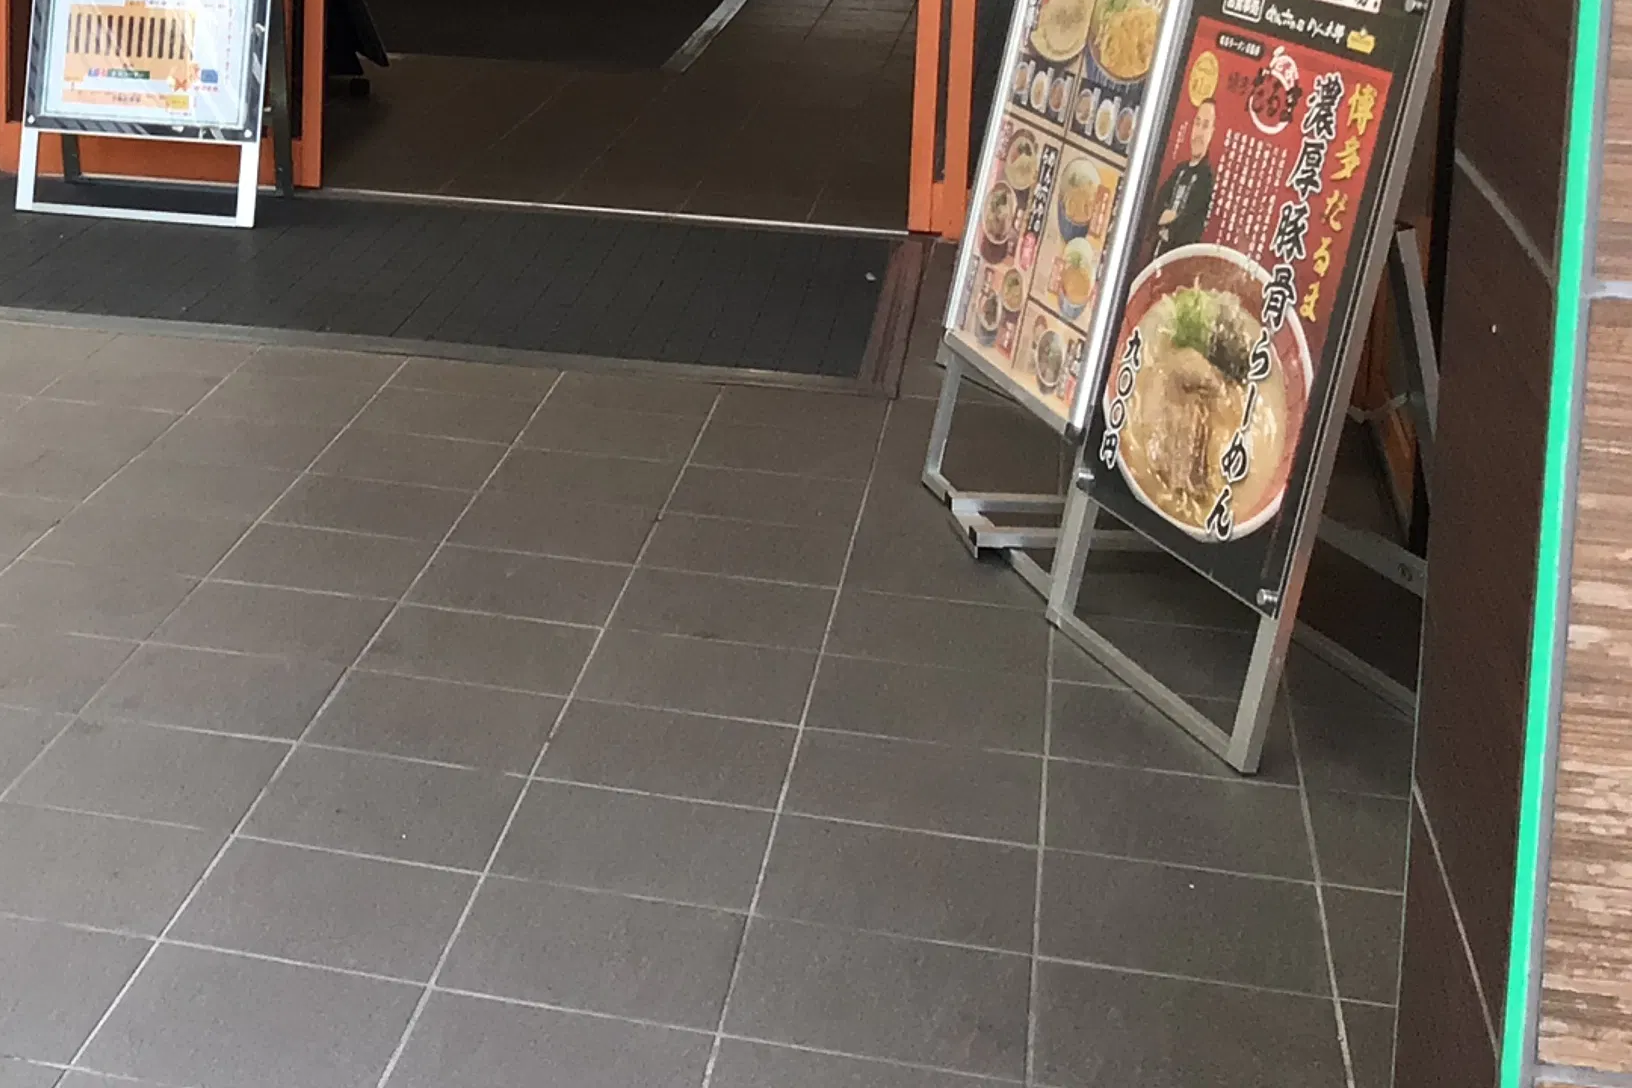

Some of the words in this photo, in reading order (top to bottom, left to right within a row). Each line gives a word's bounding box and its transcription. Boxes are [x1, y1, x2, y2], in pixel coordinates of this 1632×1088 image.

[1204, 69, 1346, 542] 濃厚豚骨らーめん
[1299, 80, 1378, 323] 博多だるま
